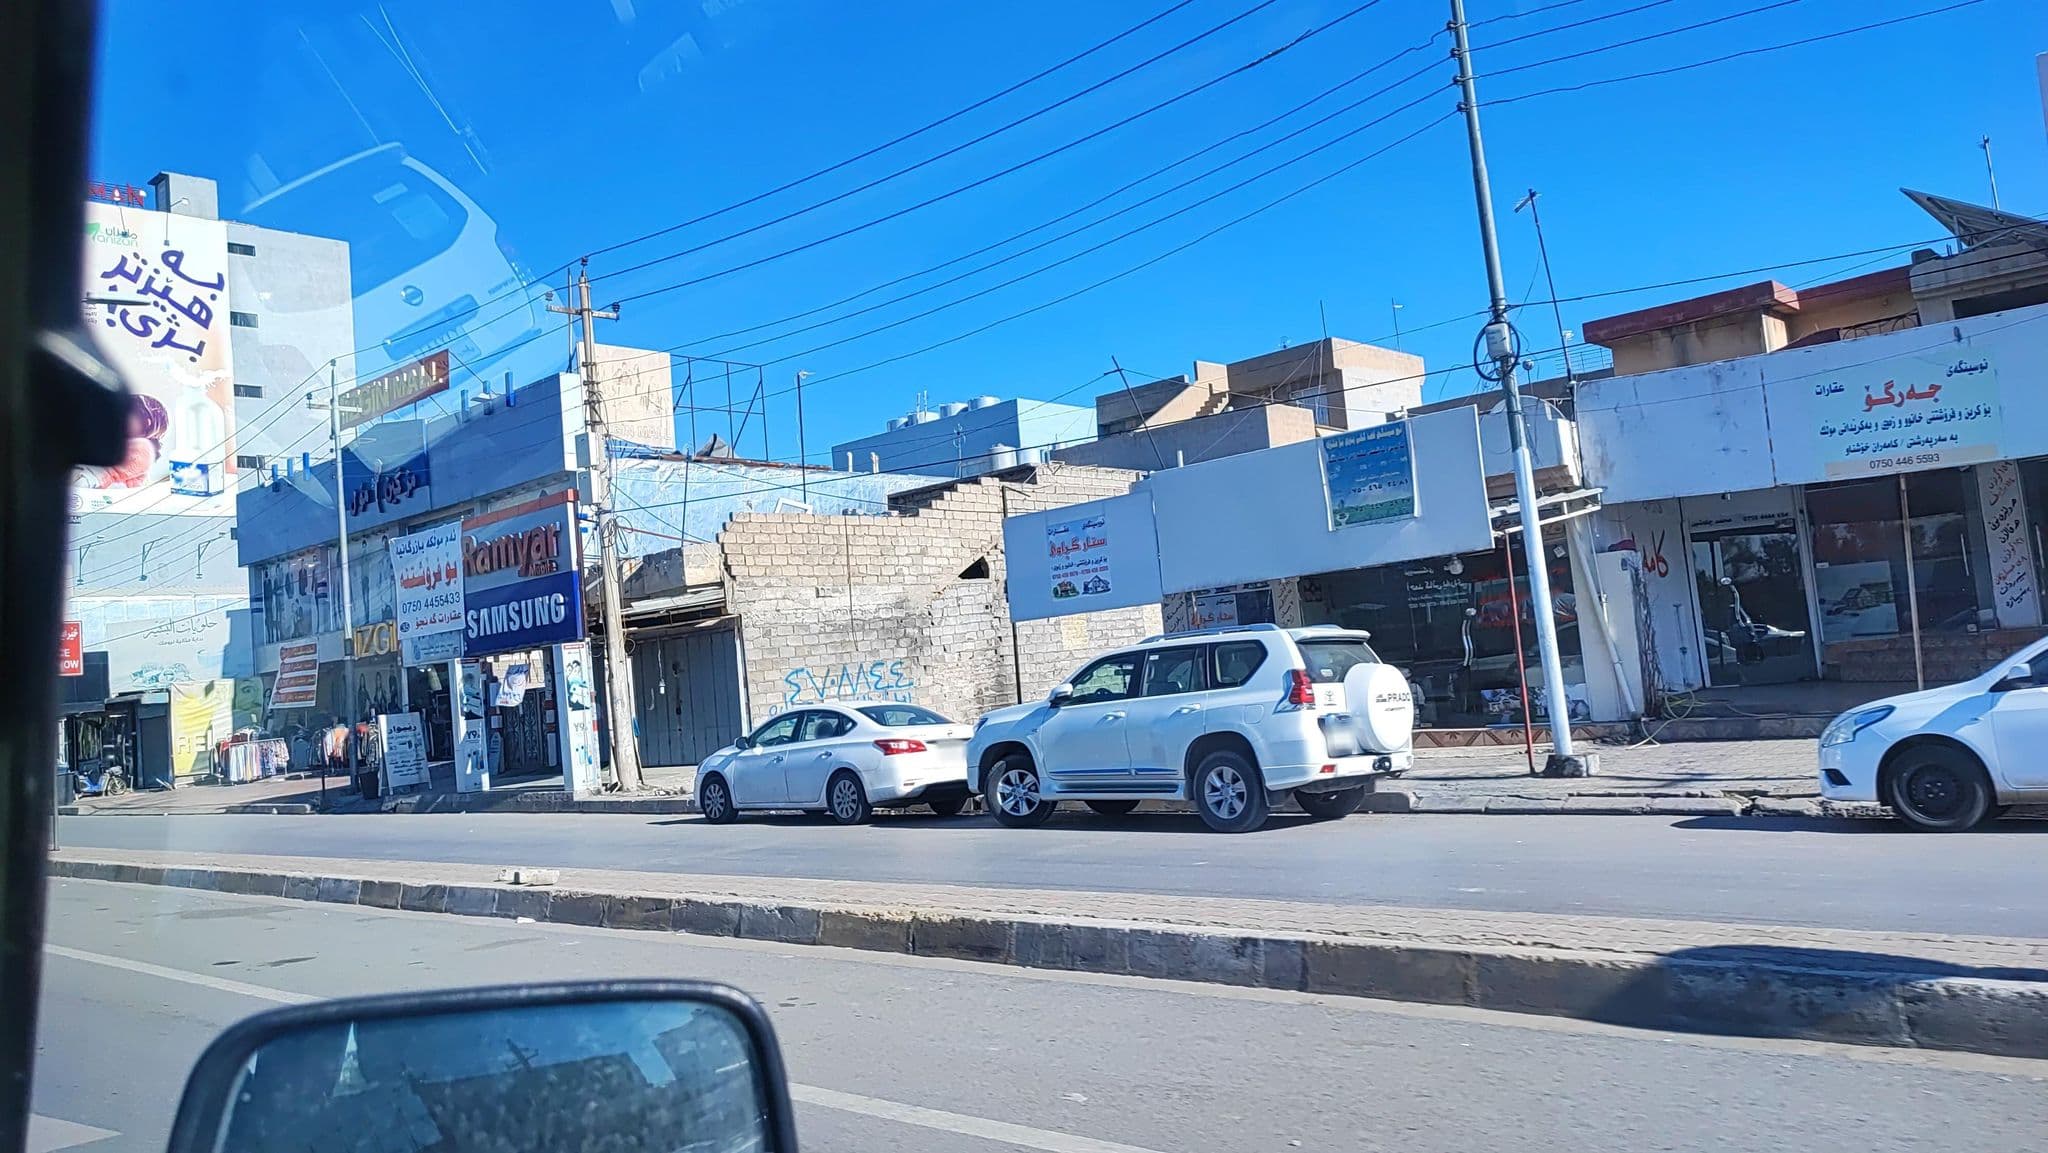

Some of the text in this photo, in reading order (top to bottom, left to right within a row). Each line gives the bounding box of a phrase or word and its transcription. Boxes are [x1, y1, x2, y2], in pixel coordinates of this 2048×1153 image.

[1869, 458, 1893, 469] 0750
[1915, 453, 1940, 464] 5593
[463, 521, 560, 577] Ramyar
[402, 591, 461, 614] 0750 4455433
[467, 592, 565, 639] SAMSUNG
